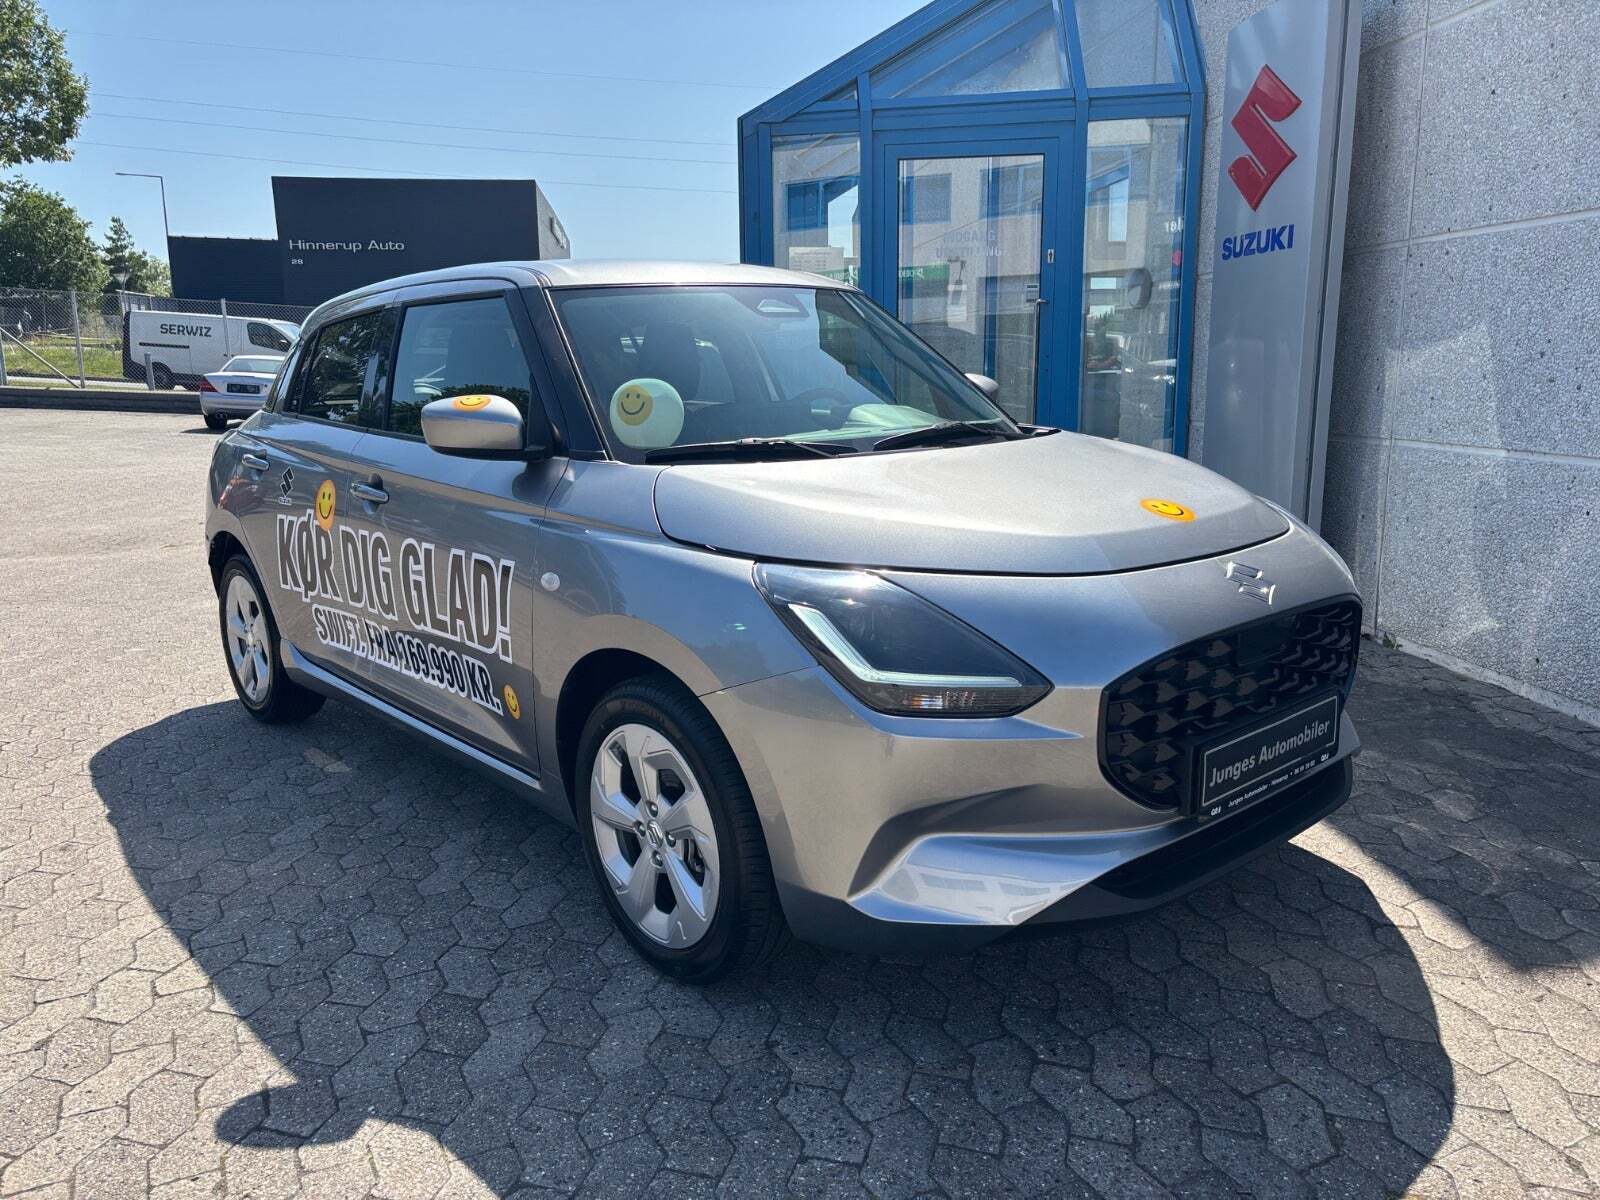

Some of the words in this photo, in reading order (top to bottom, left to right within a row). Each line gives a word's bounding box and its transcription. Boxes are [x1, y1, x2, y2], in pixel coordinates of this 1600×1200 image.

[289, 239, 363, 253] Hinnerup
[367, 239, 405, 251] Auto
[1222, 224, 1295, 260] SUZUKI
[160, 323, 213, 338] SERWIZ
[277, 509, 344, 603] KØR
[340, 526, 398, 621] DIG
[400, 538, 516, 664] GLAD!
[362, 617, 401, 672] FRA
[396, 632, 468, 698] 169.990
[462, 654, 504, 716] KR.
[1209, 755, 1256, 787] Junges
[1258, 720, 1331, 764] Automobiler
